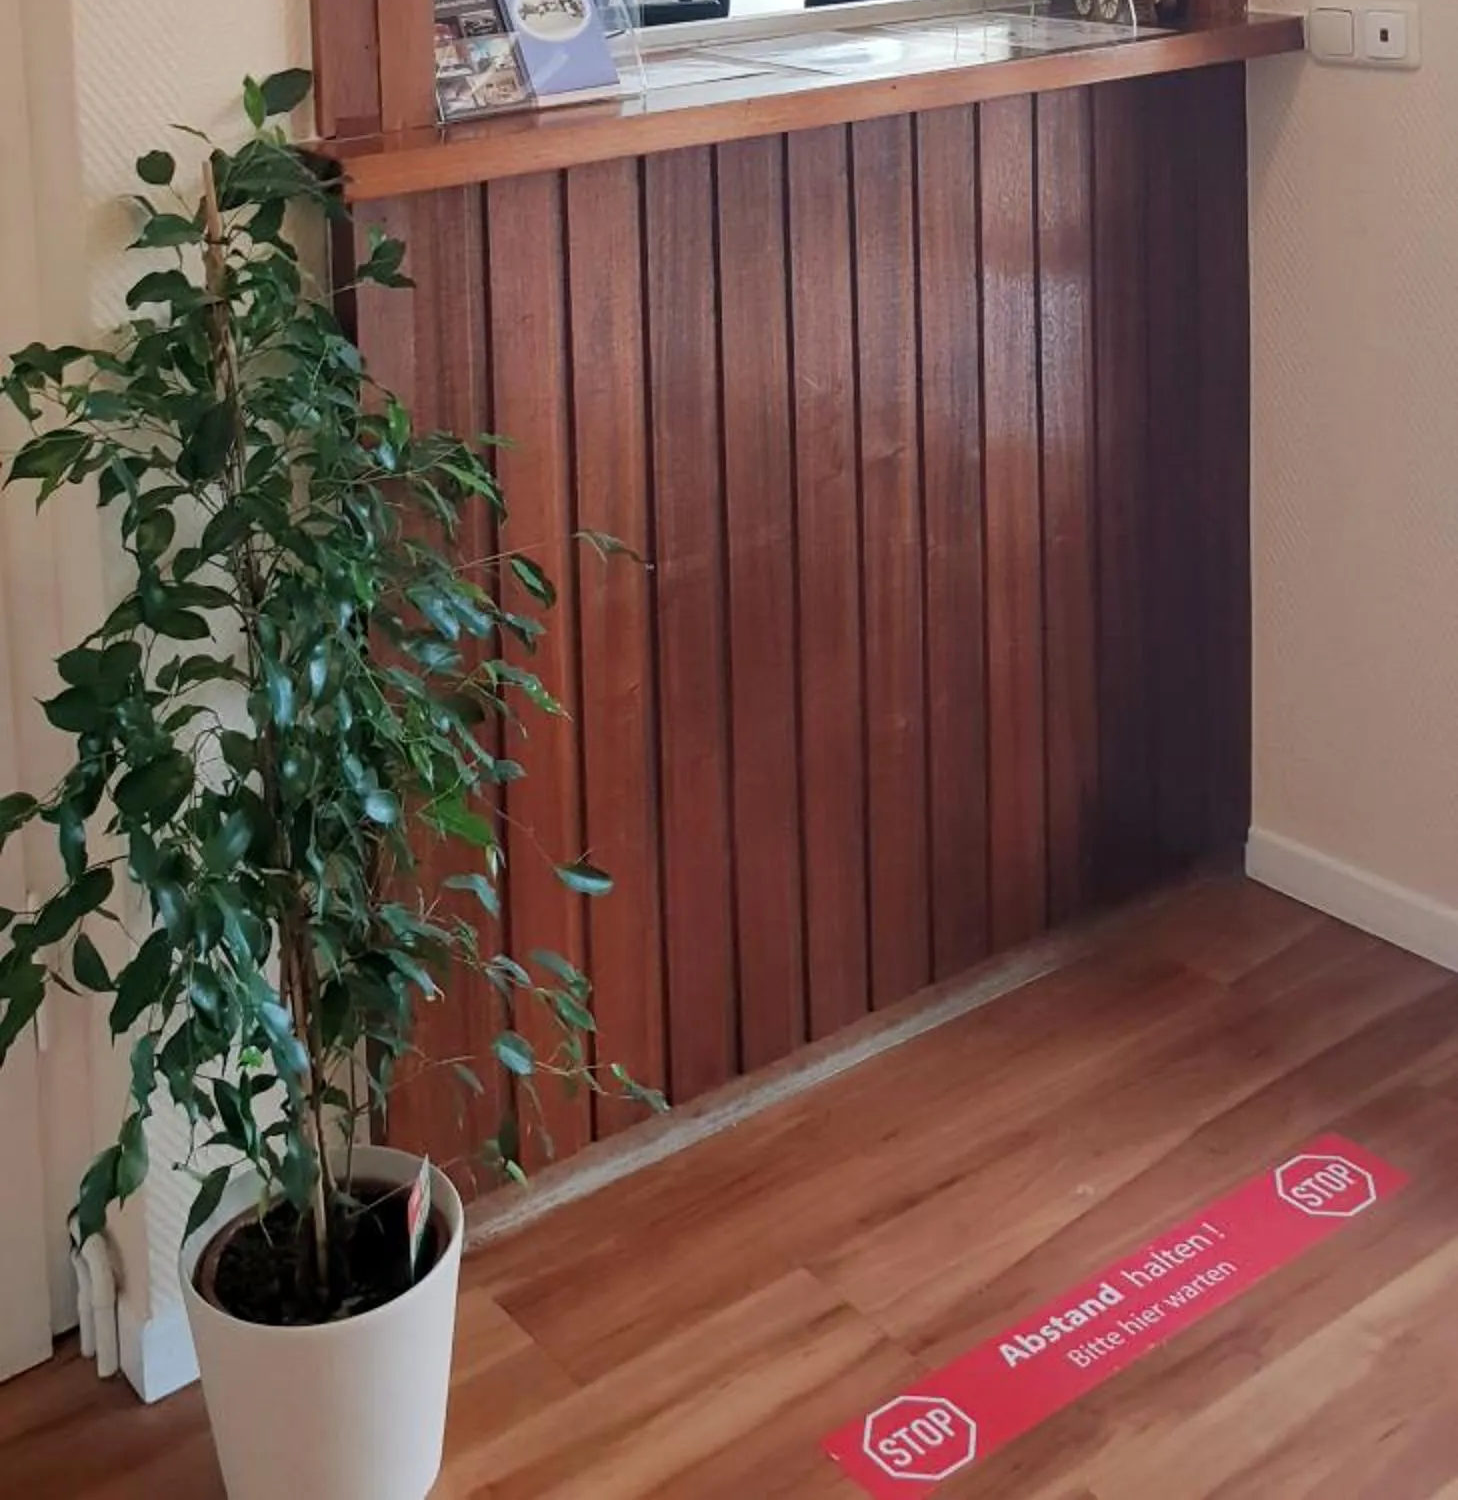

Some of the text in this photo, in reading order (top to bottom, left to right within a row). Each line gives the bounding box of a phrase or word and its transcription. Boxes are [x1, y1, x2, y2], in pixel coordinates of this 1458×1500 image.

[1290, 1163, 1356, 1207] STOP
[998, 1282, 1126, 1368] Abstand
[1067, 1260, 1238, 1368] Bitte hier warten
[879, 1408, 955, 1466] STOP
